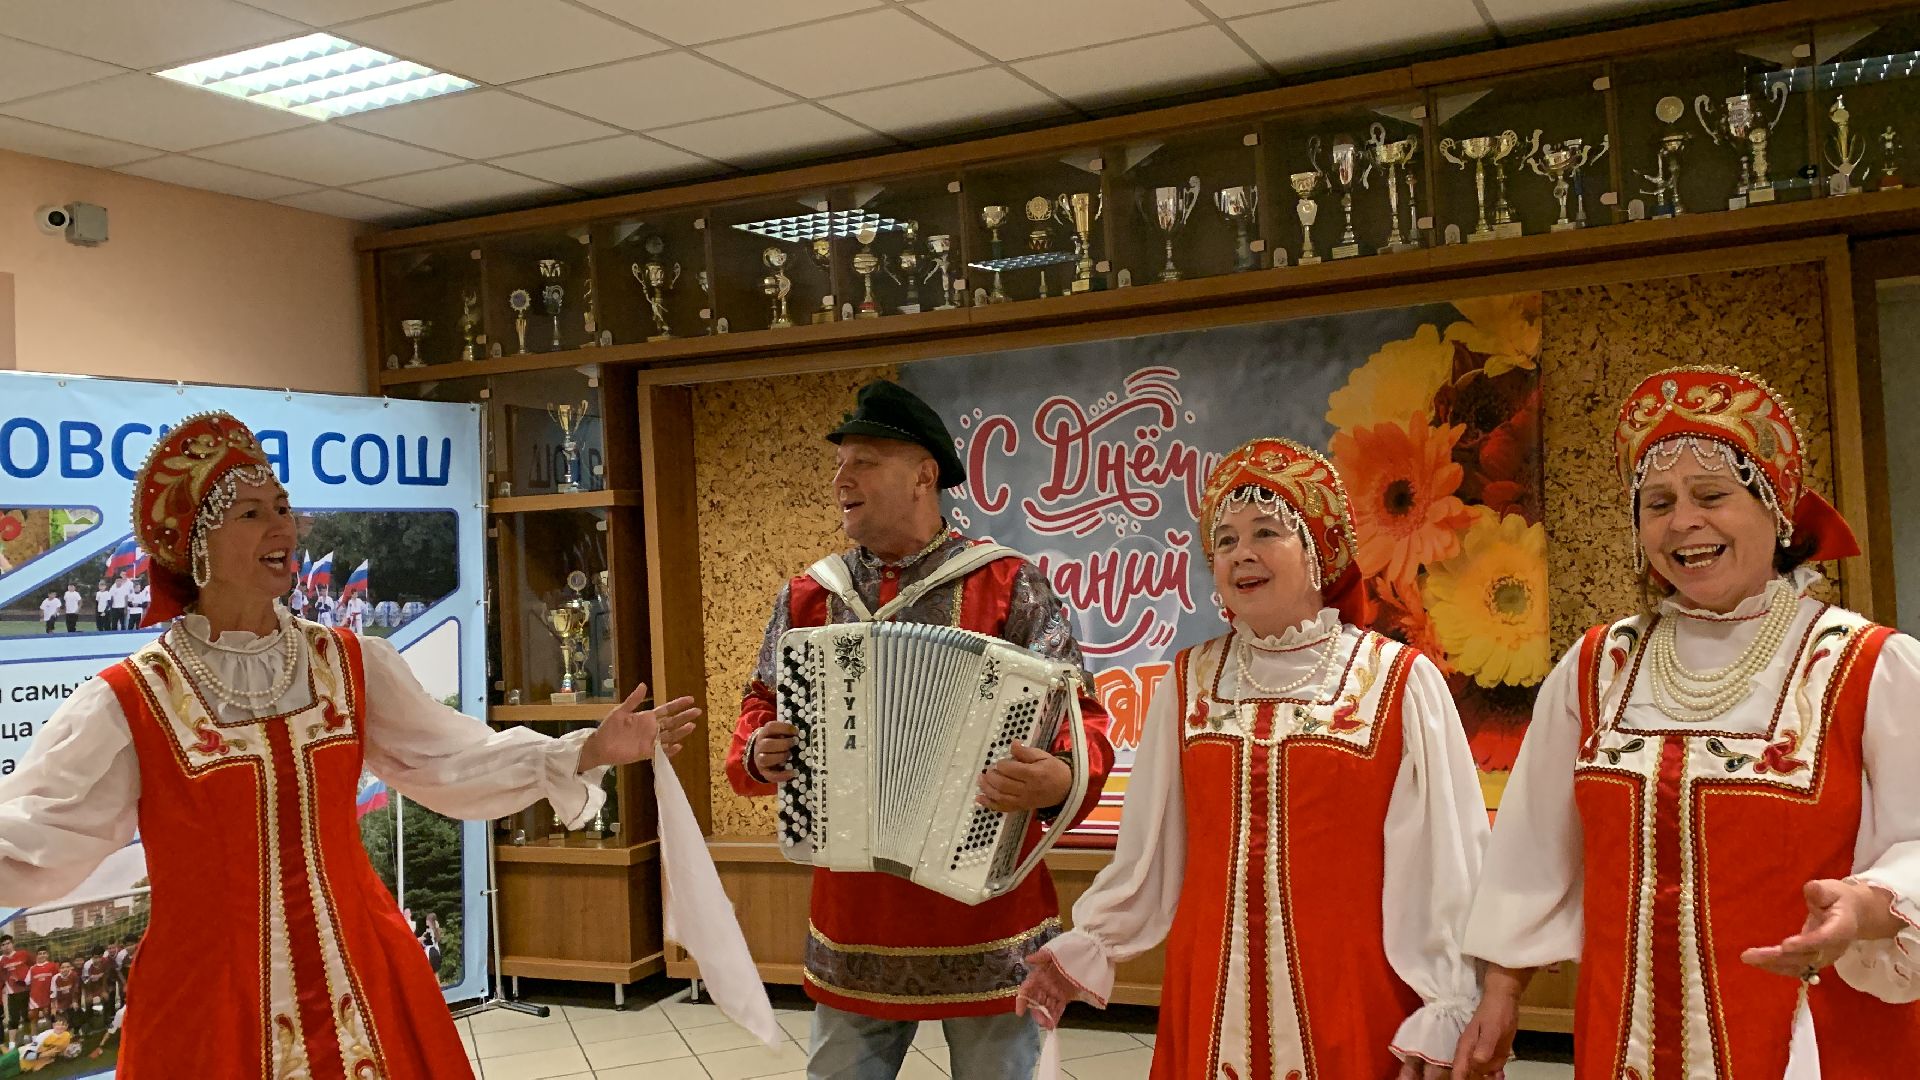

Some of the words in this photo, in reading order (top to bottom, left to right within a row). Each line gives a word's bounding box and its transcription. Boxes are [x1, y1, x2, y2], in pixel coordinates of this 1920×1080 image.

[0, 417, 290, 484] ОВСЯ
[311, 431, 451, 486] СОШ
[969, 415, 1019, 515] С
[1022, 396, 1201, 520] Днём
[1038, 530, 1194, 625] аний
[11, 675, 93, 702] самы
[843, 678, 857, 750] ТУЛА
